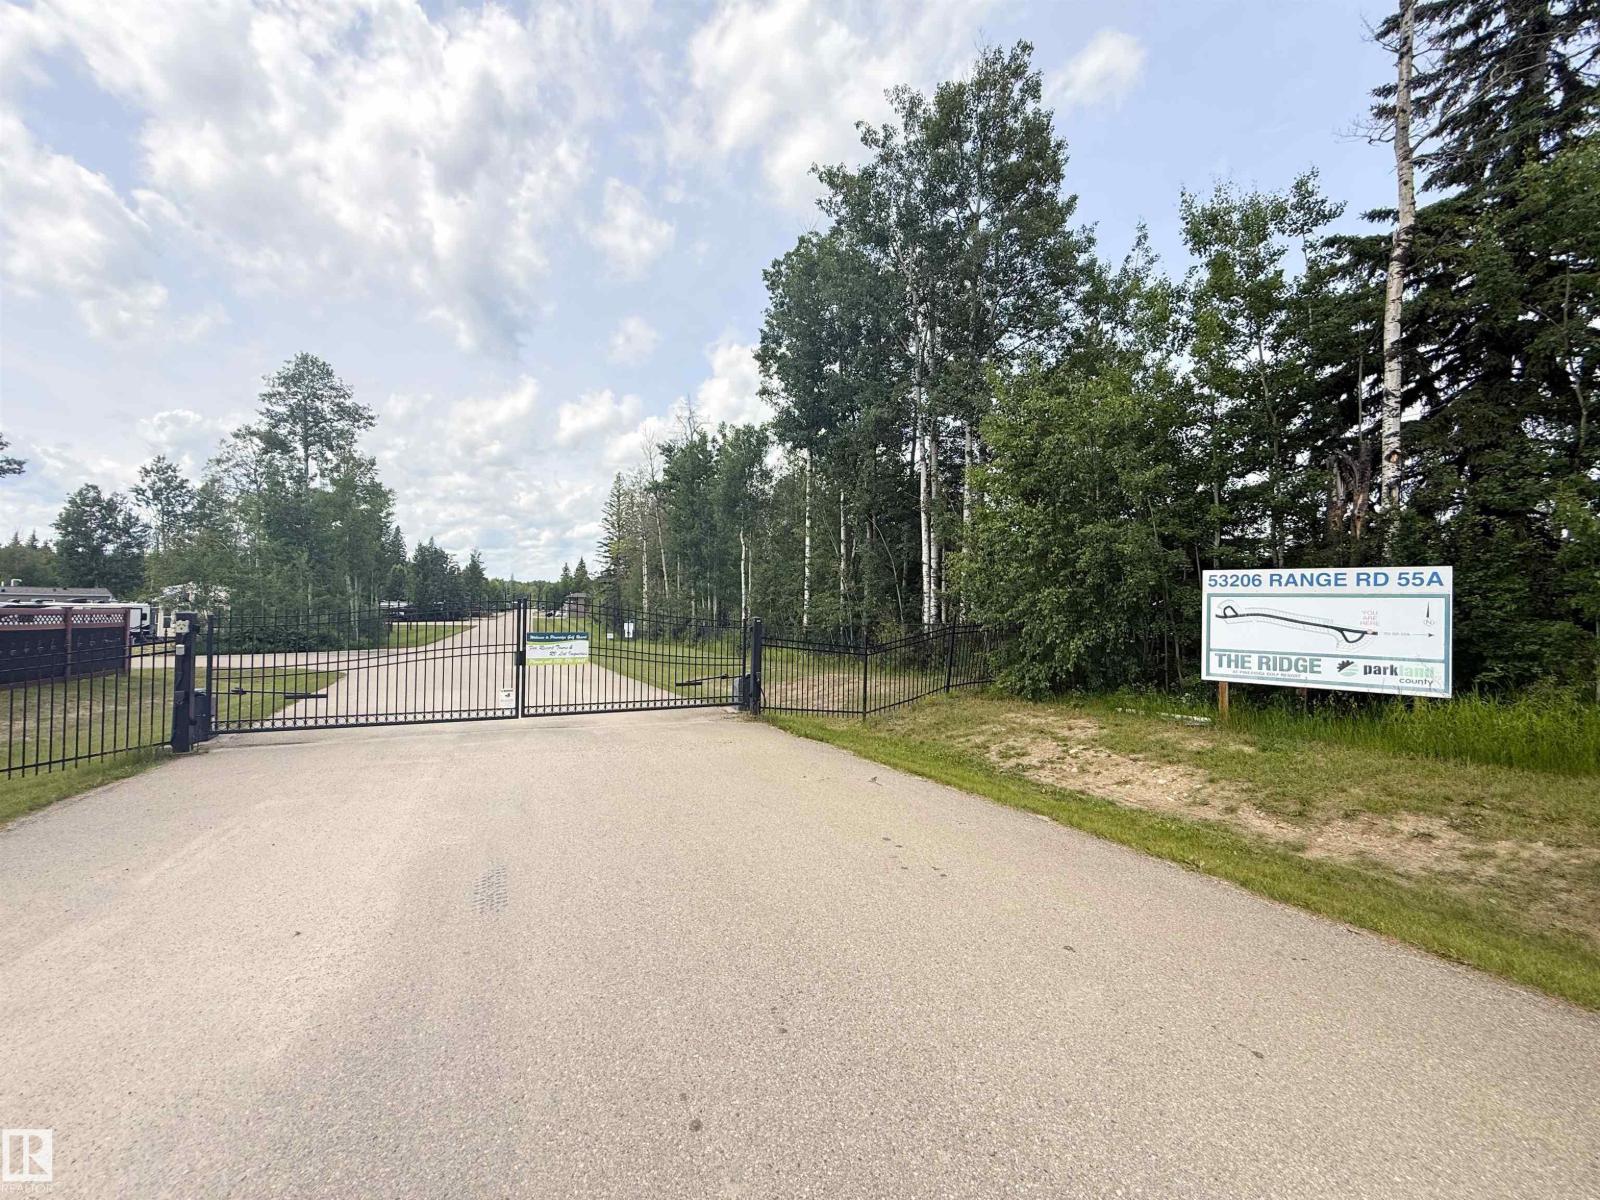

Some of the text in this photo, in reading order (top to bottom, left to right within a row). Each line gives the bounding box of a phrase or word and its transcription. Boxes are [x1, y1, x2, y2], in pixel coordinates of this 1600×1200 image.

[1208, 571, 1444, 588] 53206 RANGE RD 55A
[1215, 653, 1322, 674] THE RIDGE
[1363, 664, 1434, 678] parkland
[1399, 677, 1434, 687] county
